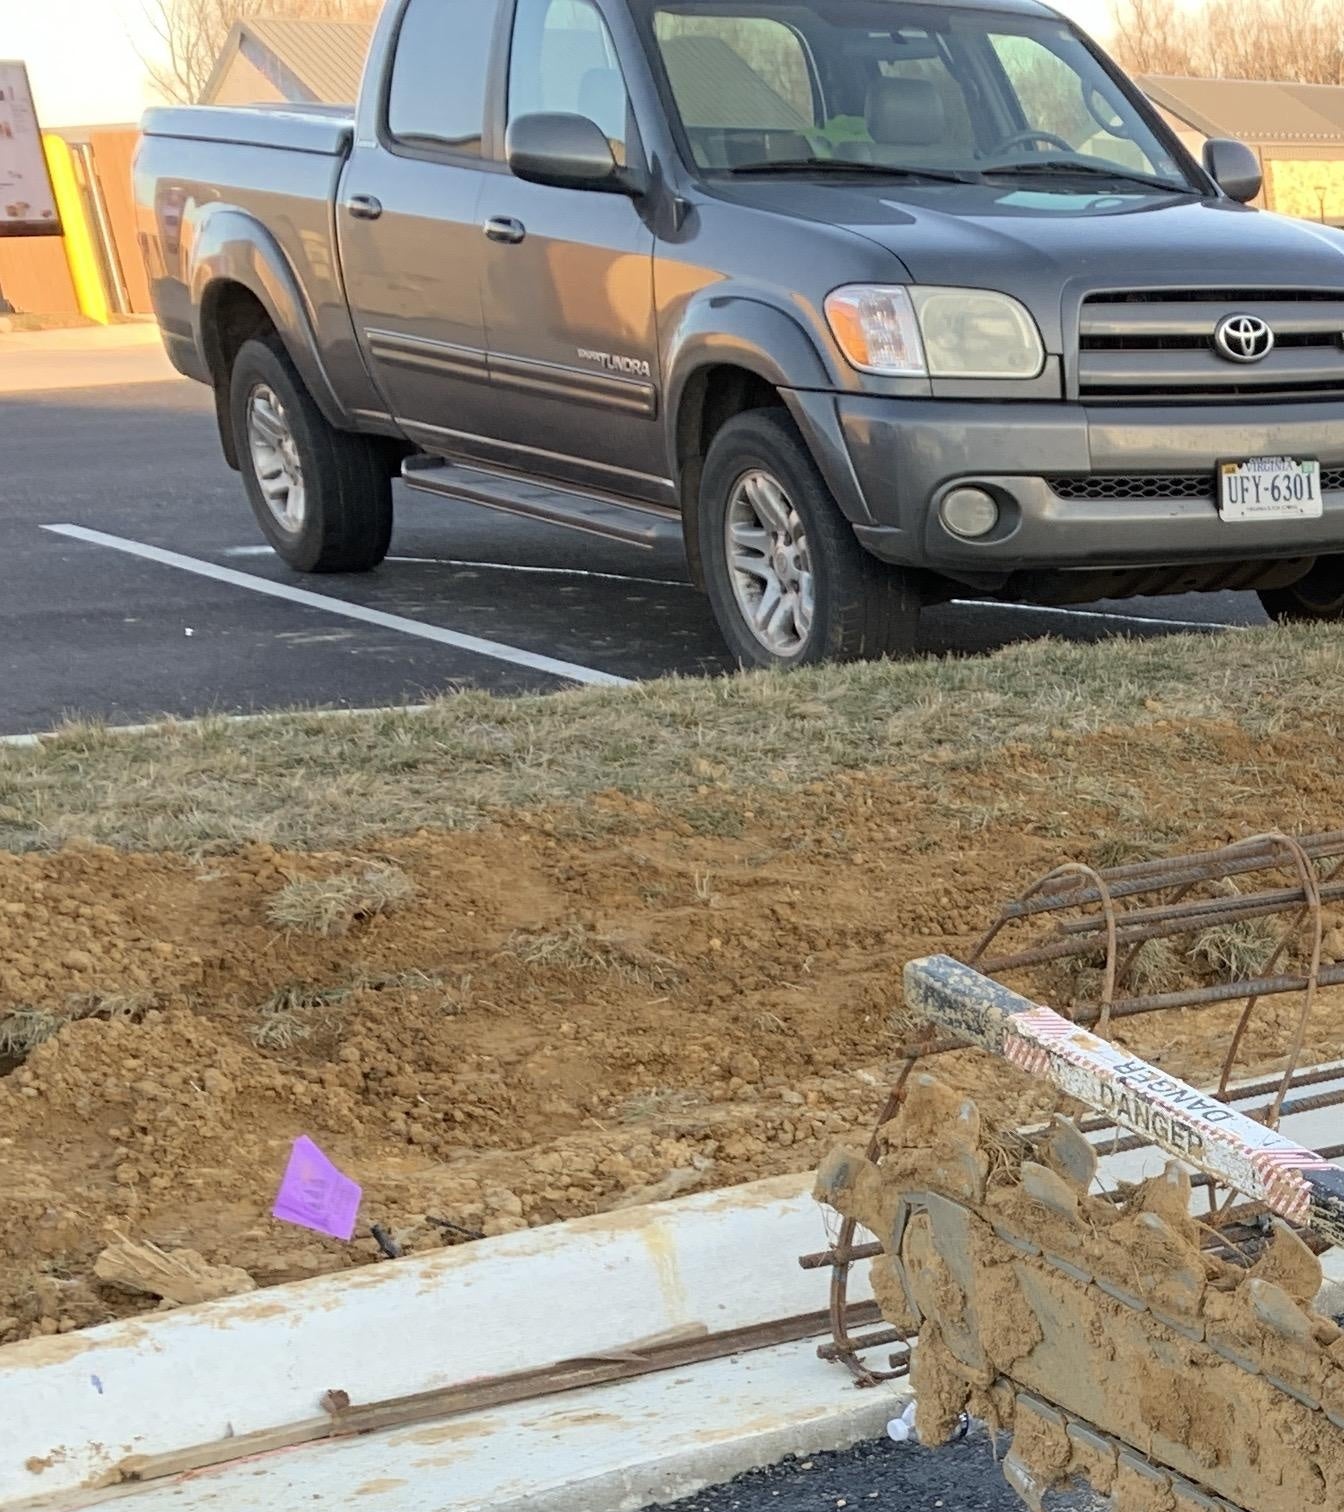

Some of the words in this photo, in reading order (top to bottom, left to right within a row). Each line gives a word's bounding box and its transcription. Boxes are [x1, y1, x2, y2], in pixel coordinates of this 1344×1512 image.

[600, 352, 651, 377] TUNDRA
[1245, 461, 1294, 473] VIRGINIA
[1227, 473, 1314, 504] UFY-6301
[1113, 1060, 1235, 1123] DANGER
